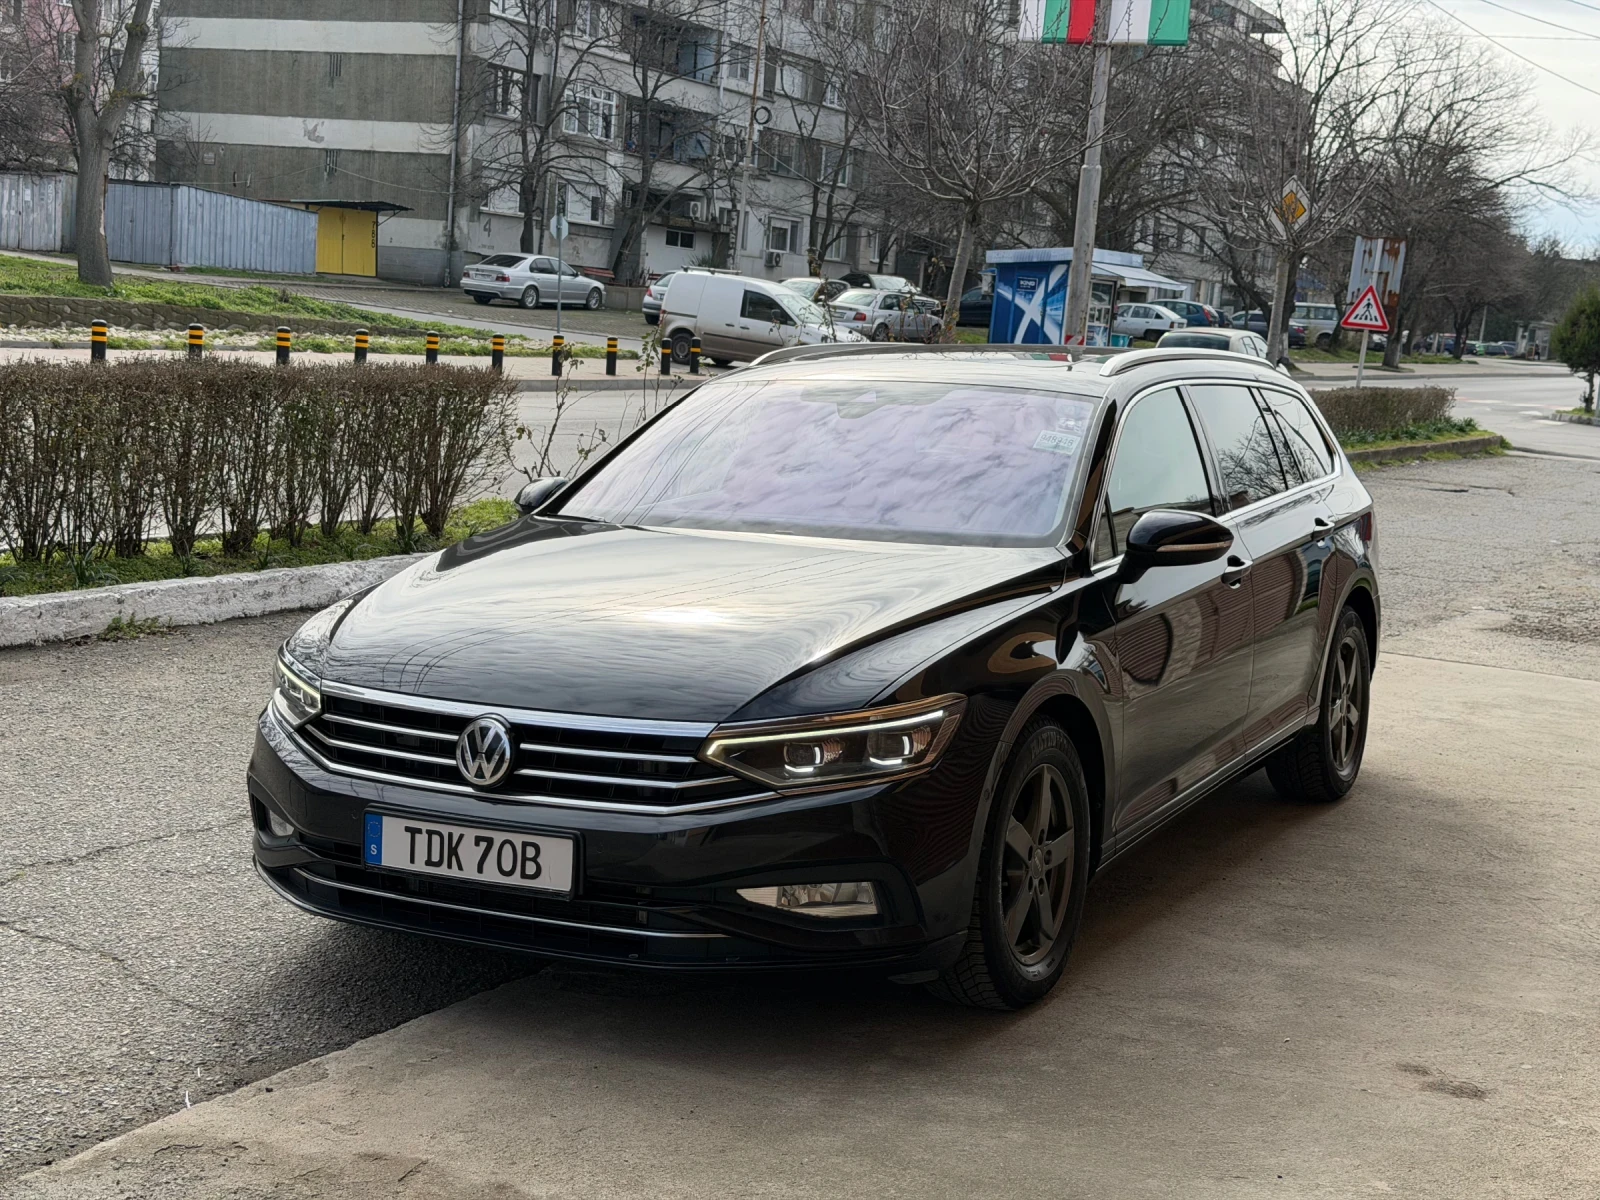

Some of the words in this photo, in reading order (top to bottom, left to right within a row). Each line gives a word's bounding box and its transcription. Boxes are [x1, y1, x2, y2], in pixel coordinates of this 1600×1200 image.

[483, 217, 492, 238] 4
[370, 844, 378, 855] S
[404, 825, 465, 871] TDK
[474, 835, 542, 880] 70B
